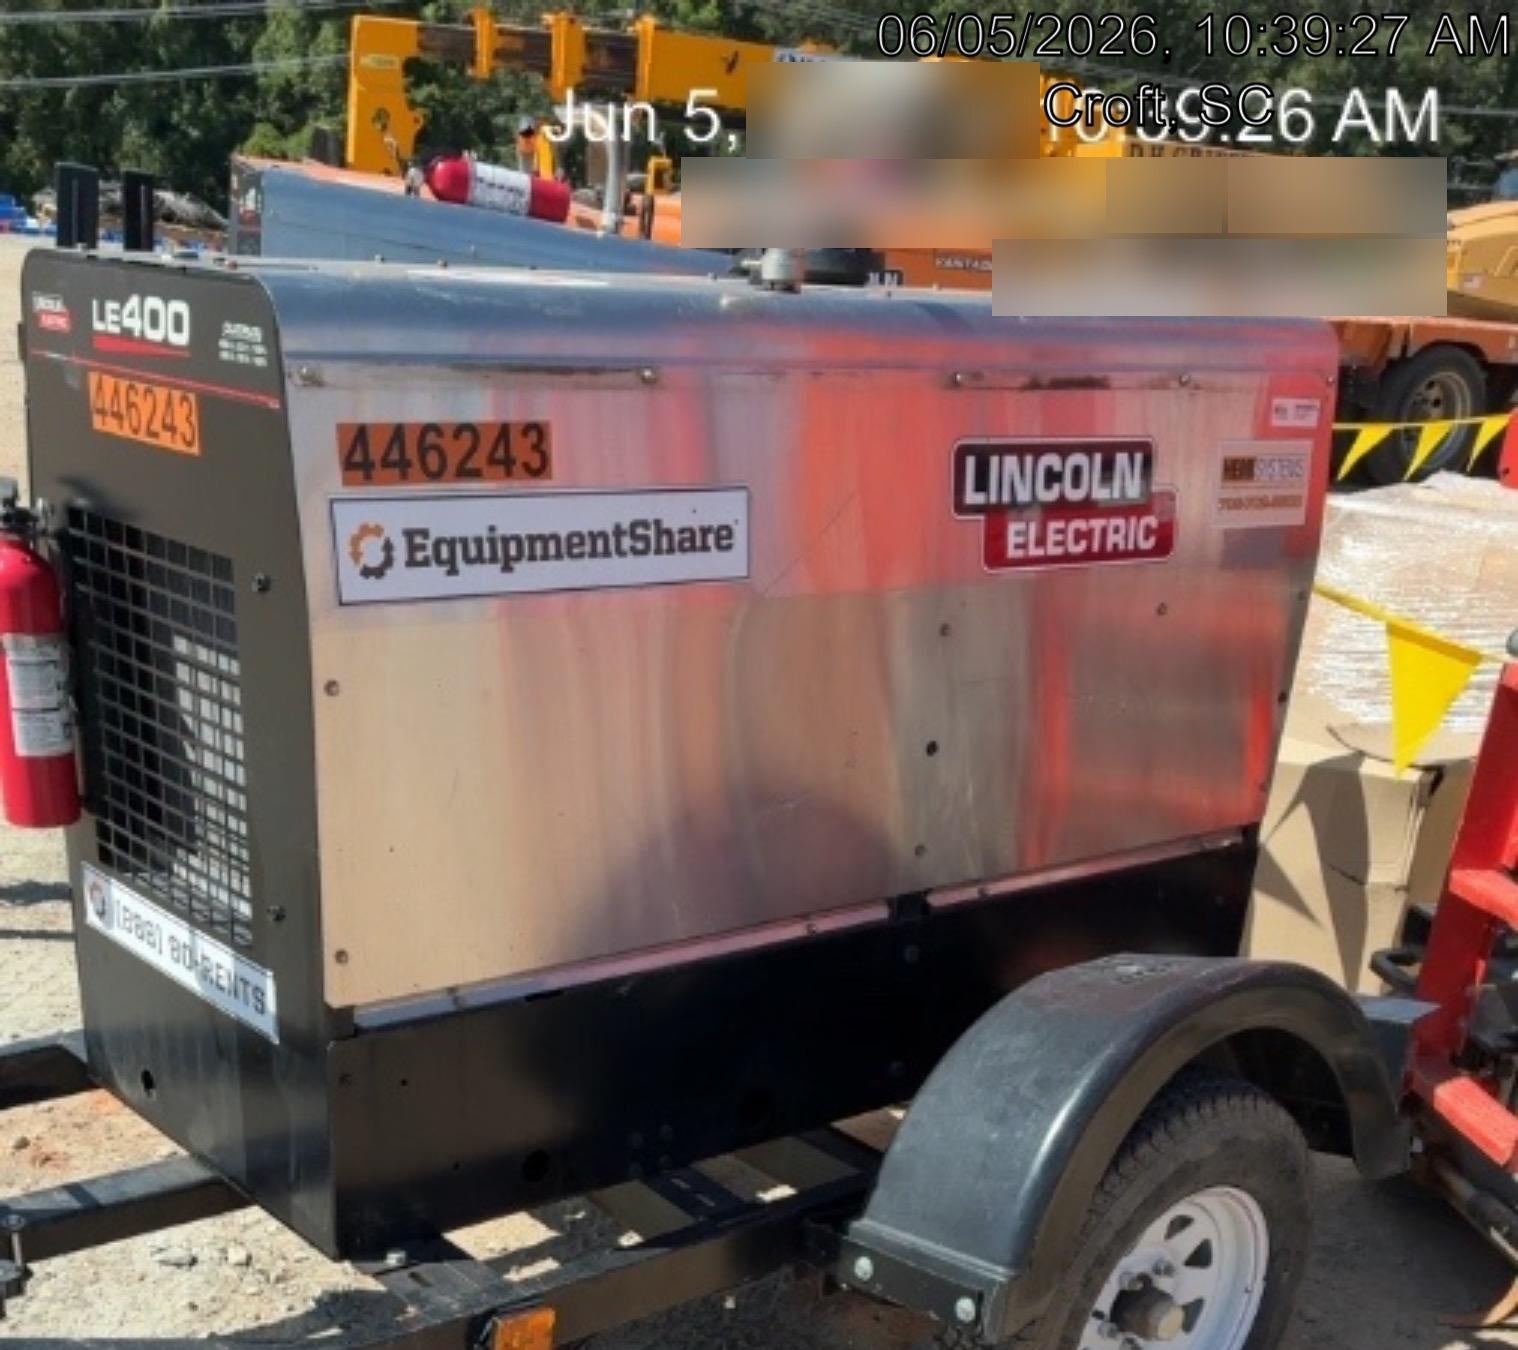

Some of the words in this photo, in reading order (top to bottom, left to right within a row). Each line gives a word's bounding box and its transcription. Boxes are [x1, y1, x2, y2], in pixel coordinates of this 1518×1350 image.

[92, 294, 190, 346] LE400
[95, 374, 197, 447] 446243
[343, 422, 549, 480] 446243
[964, 452, 1143, 505] LINCOLN
[402, 518, 734, 576] EquipmentShare
[1007, 515, 1159, 559] ELECTRIC
